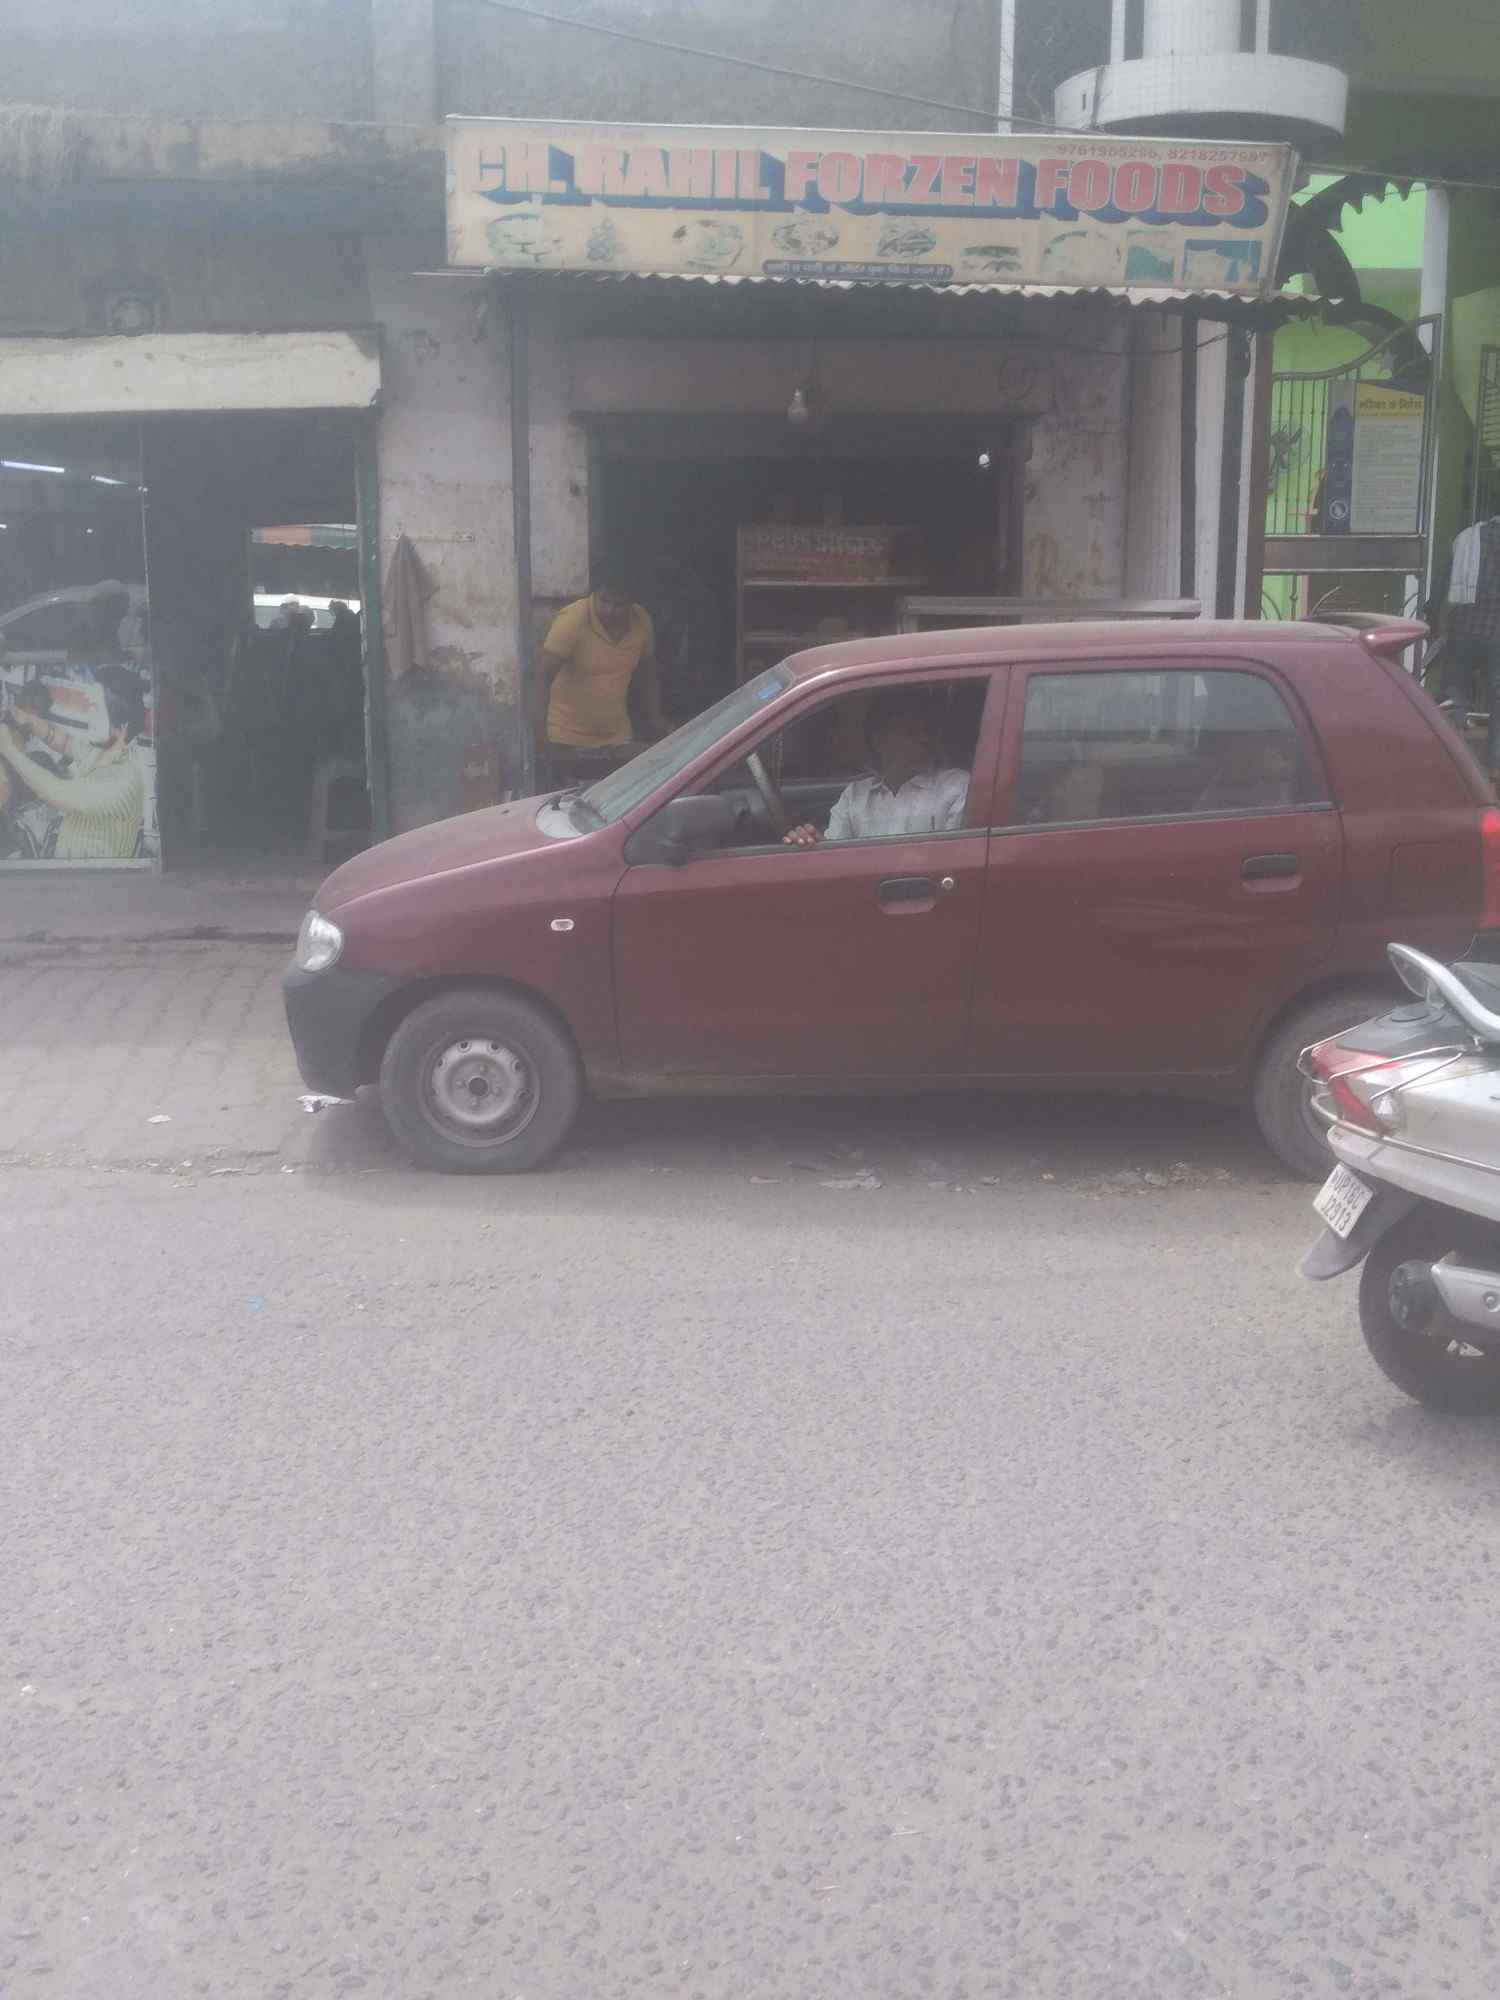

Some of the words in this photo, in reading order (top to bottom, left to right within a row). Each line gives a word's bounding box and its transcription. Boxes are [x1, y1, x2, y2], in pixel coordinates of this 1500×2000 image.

[584, 143, 773, 200] RAHIL
[786, 151, 1019, 208] FORZEN
[1034, 158, 1246, 216] FOODS
